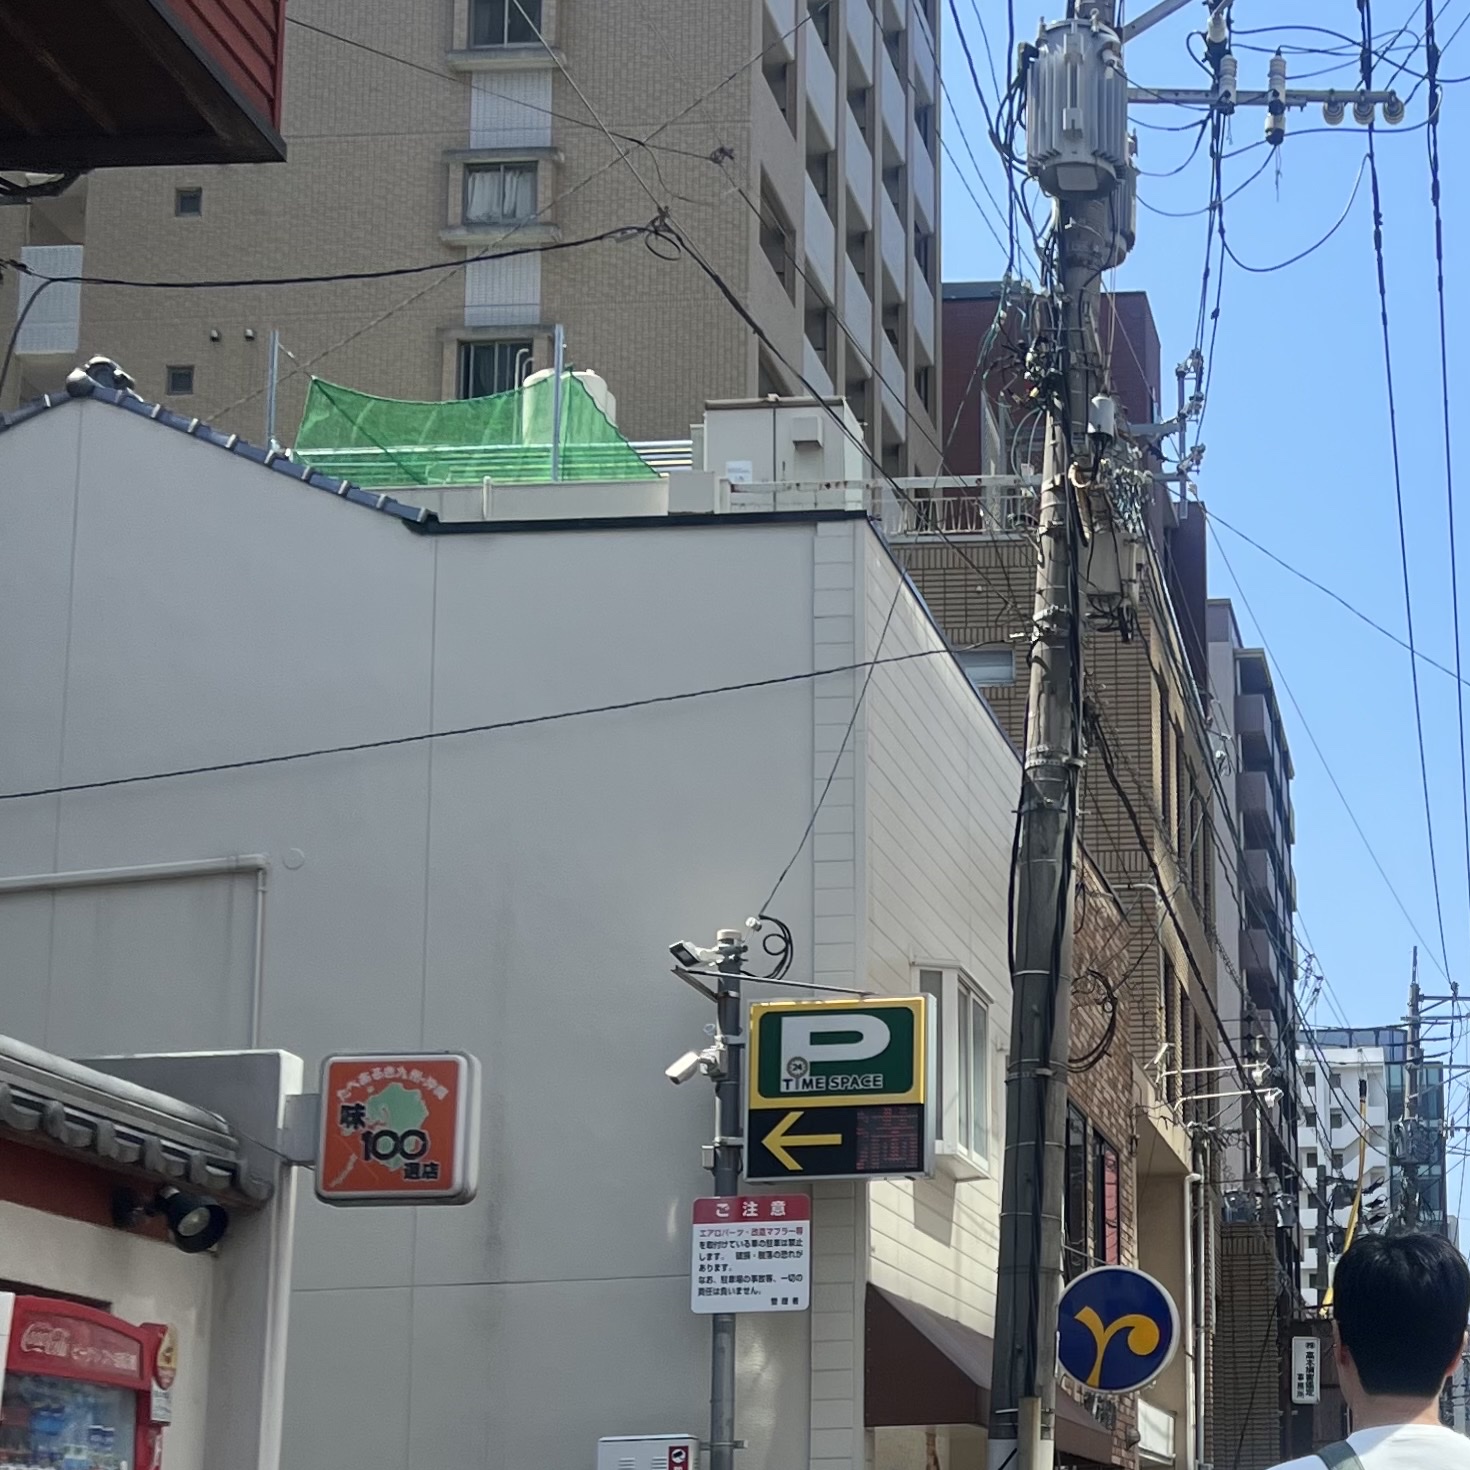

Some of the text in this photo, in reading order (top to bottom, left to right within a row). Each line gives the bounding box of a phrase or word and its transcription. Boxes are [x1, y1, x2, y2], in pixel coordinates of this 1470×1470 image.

[782, 1074, 883, 1091] TIME SPACE
[339, 1103, 366, 1130] 味
[361, 1129, 428, 1161] 100
[716, 1201, 786, 1217] ご注意
[699, 1264, 732, 1272] あります。
